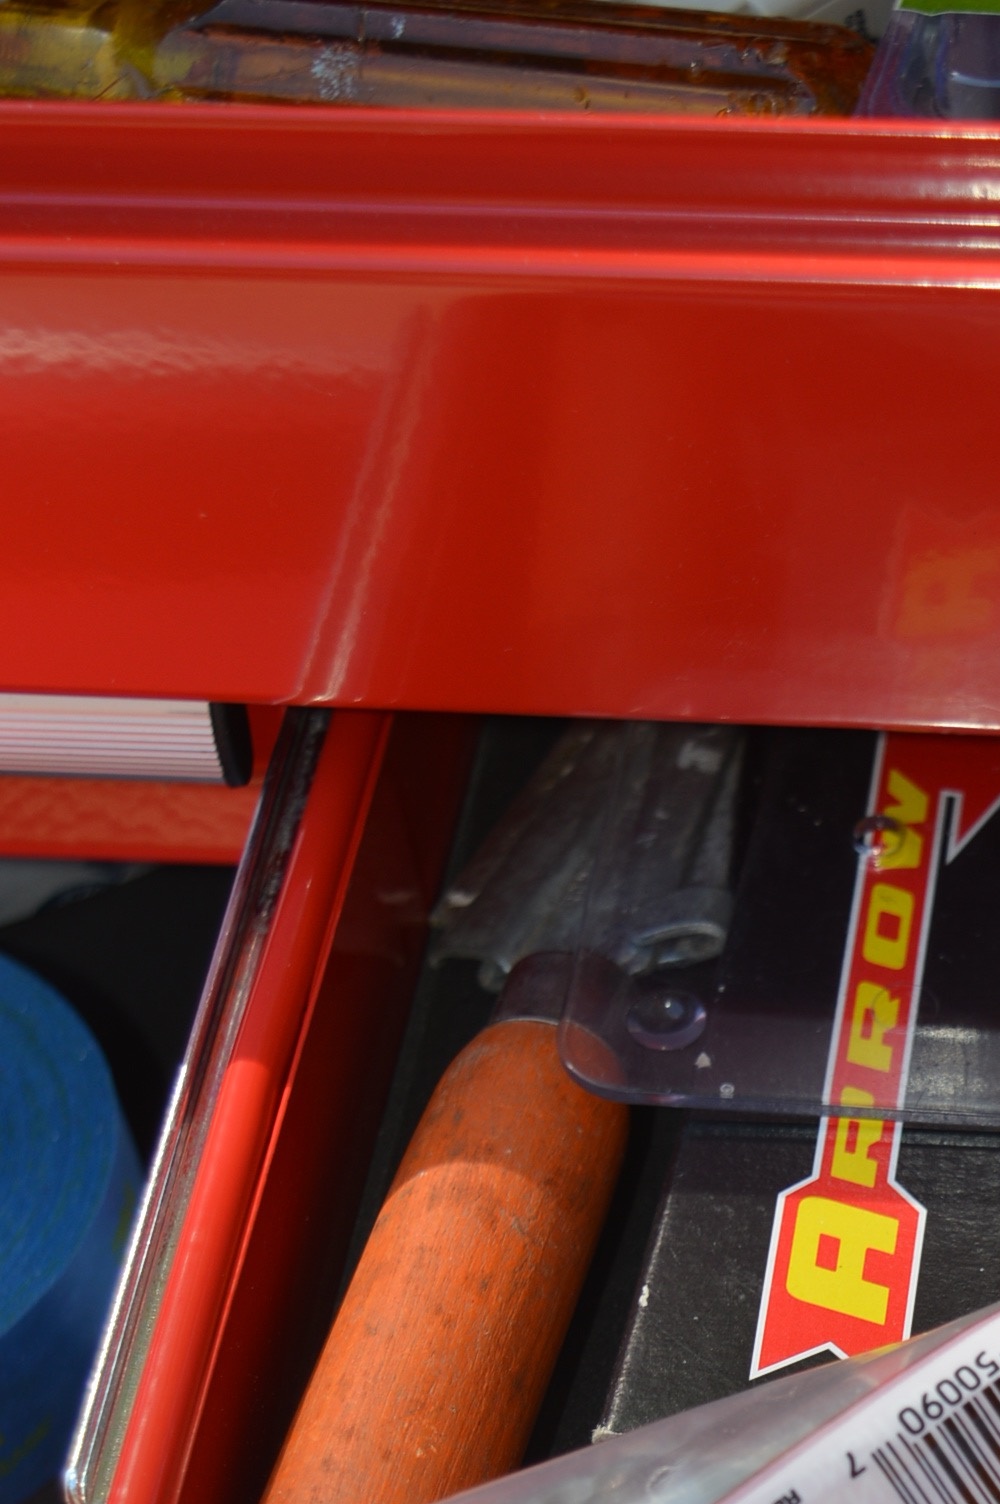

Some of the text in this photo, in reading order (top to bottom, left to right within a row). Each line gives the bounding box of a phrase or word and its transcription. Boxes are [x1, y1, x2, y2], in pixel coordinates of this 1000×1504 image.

[786, 770, 928, 1324] ARROW
[895, 1348, 1000, 1438] 50090
[842, 1450, 866, 1480] 7
